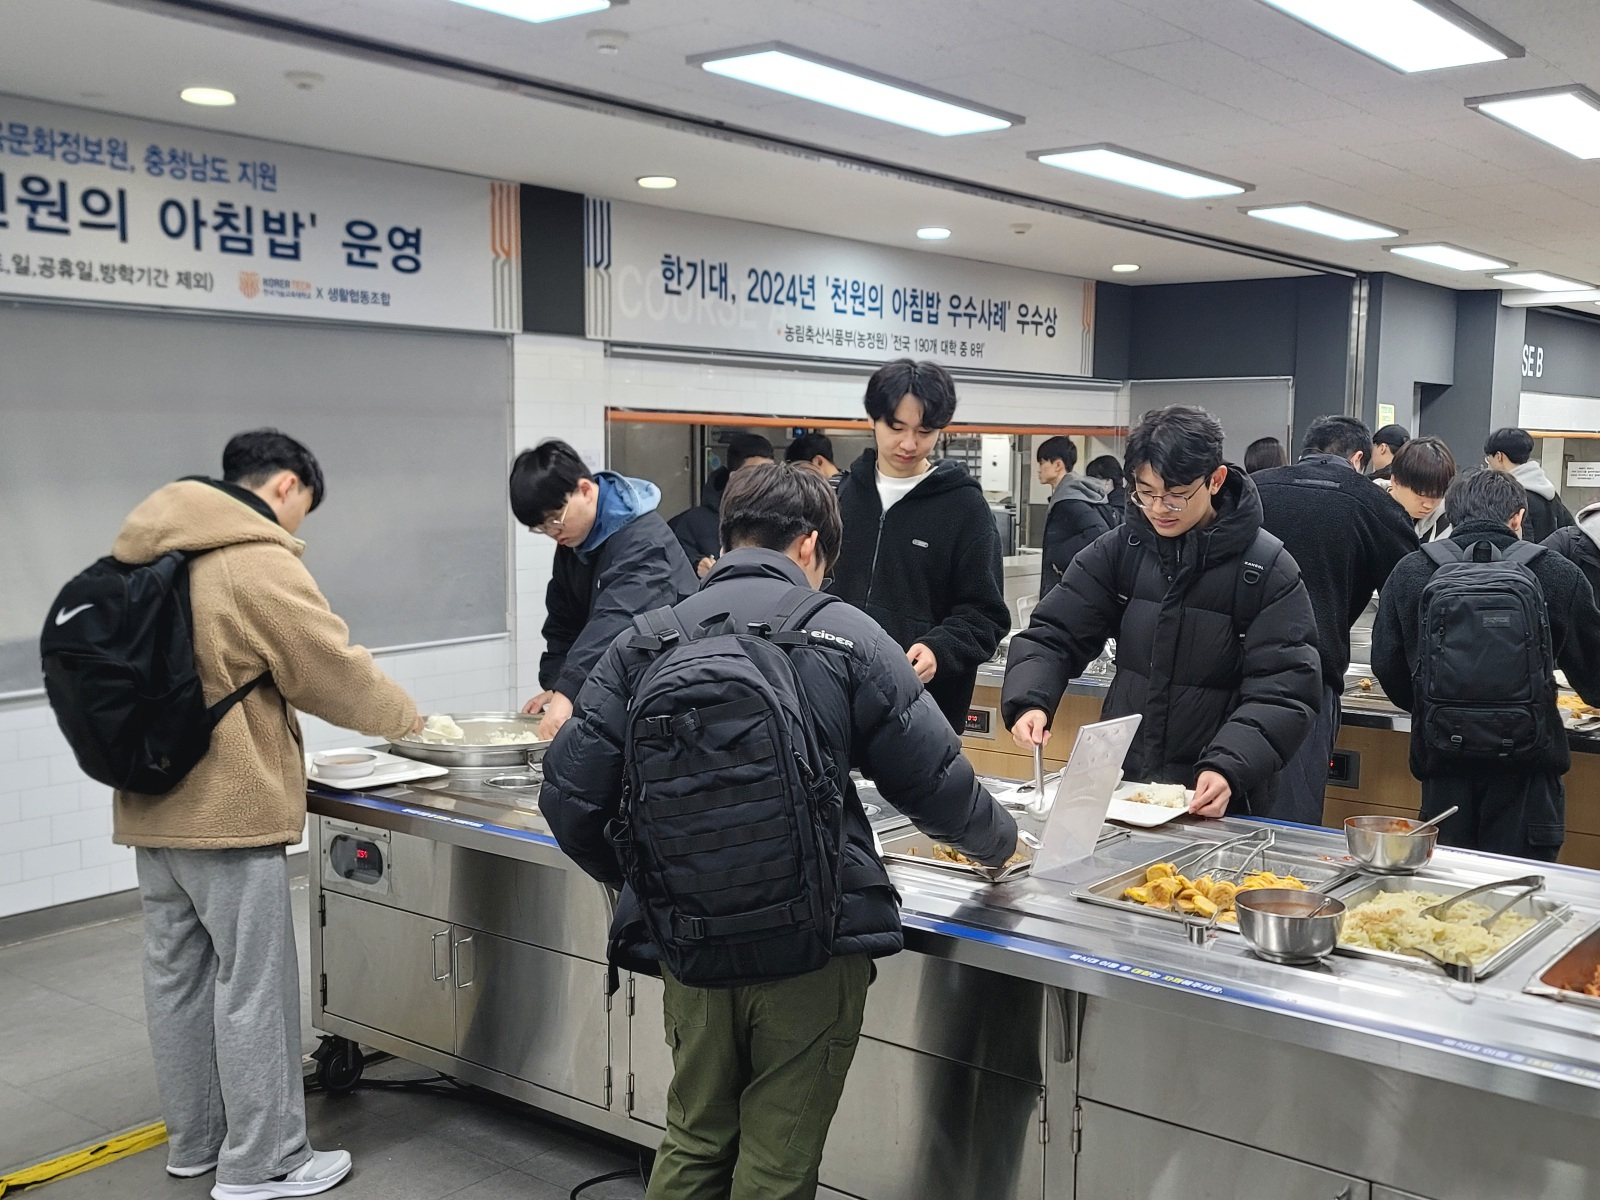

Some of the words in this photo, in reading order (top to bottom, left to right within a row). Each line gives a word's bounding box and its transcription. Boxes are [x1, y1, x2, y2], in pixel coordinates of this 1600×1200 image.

[0, 121, 136, 174] 문화정보원,
[144, 143, 231, 182] 충청남도
[238, 160, 278, 193] 지원
[0, 171, 128, 243] 원의
[159, 198, 317, 262] 아침밥'
[341, 219, 422, 275] 운영
[0, 252, 169, 288] ,일,공휴일,방학기간
[176, 270, 214, 292] 제외)
[660, 253, 736, 304] 한기대,
[747, 267, 816, 311] 2024년
[825, 275, 884, 320] '천원의
[892, 286, 941, 326] 아침밥
[947, 293, 1011, 333] 우수사례'
[1016, 302, 1058, 339] 우수상
[784, 324, 888, 350] 농림축산식품부(농정원)
[914, 338, 938, 354] 190개
[940, 339, 957, 358] 대학
[959, 342, 968, 358] 중
[1536, 347, 1544, 378] B
